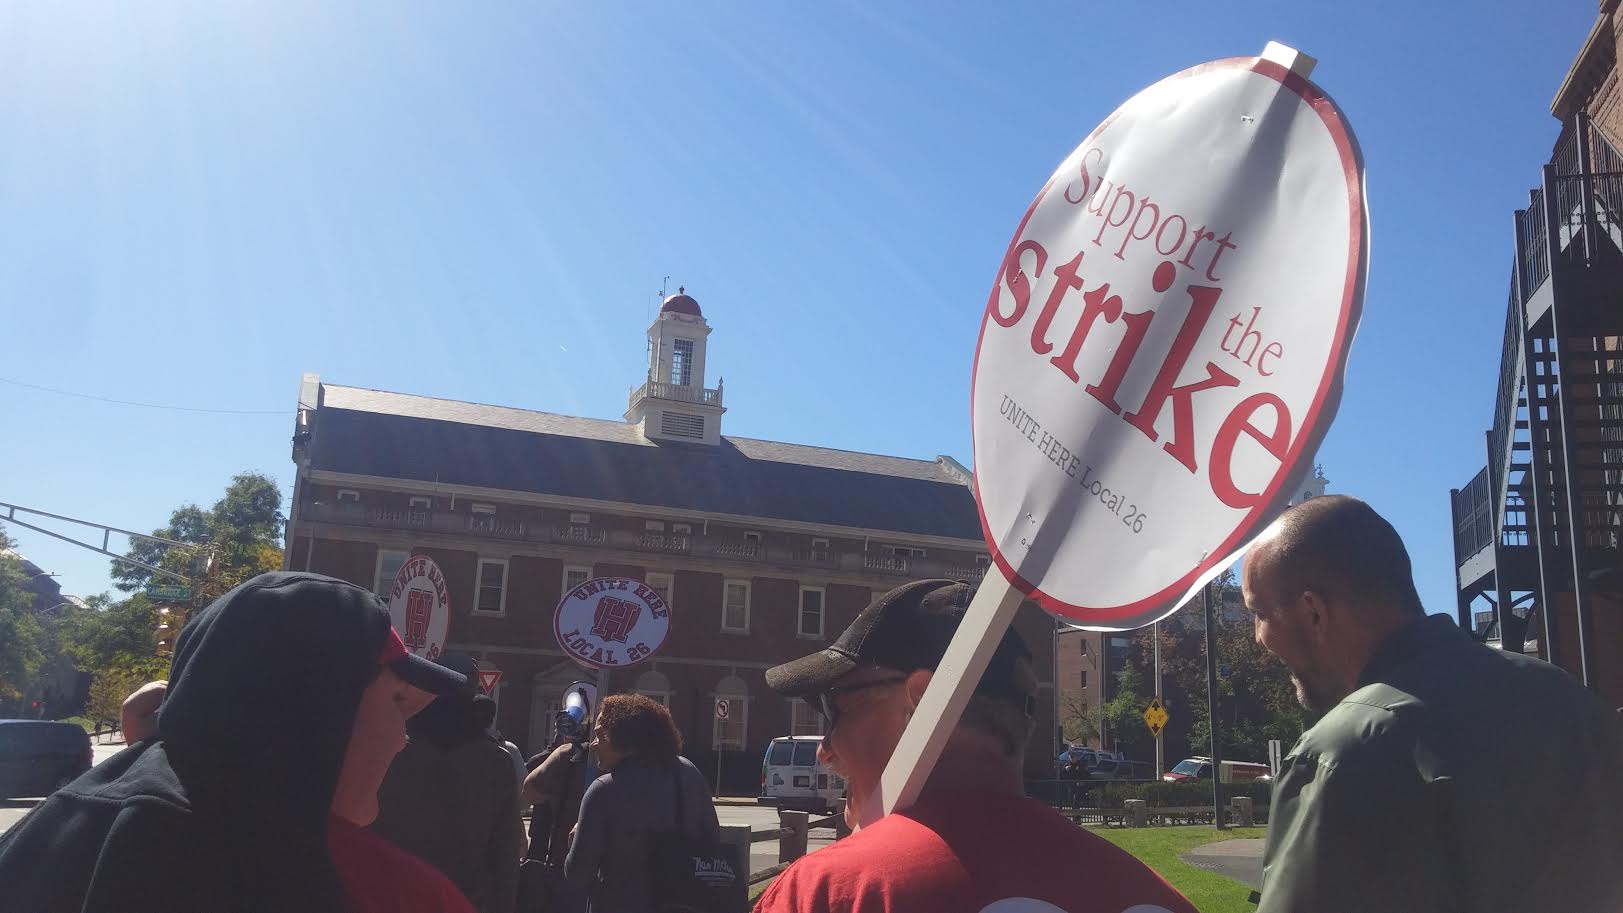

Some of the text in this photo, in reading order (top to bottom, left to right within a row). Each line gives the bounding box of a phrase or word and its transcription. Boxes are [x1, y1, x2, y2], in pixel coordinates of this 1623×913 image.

[1064, 148, 1237, 282] Support
[1219, 306, 1284, 377] the
[990, 239, 1292, 509] strike
[1000, 394, 1147, 534] UNITE HERE Local 26
[394, 559, 447, 609] UNITE HERE
[572, 579, 668, 620] UNITE HERE
[562, 629, 651, 665] LOCAL 26
[589, 594, 641, 644] H
